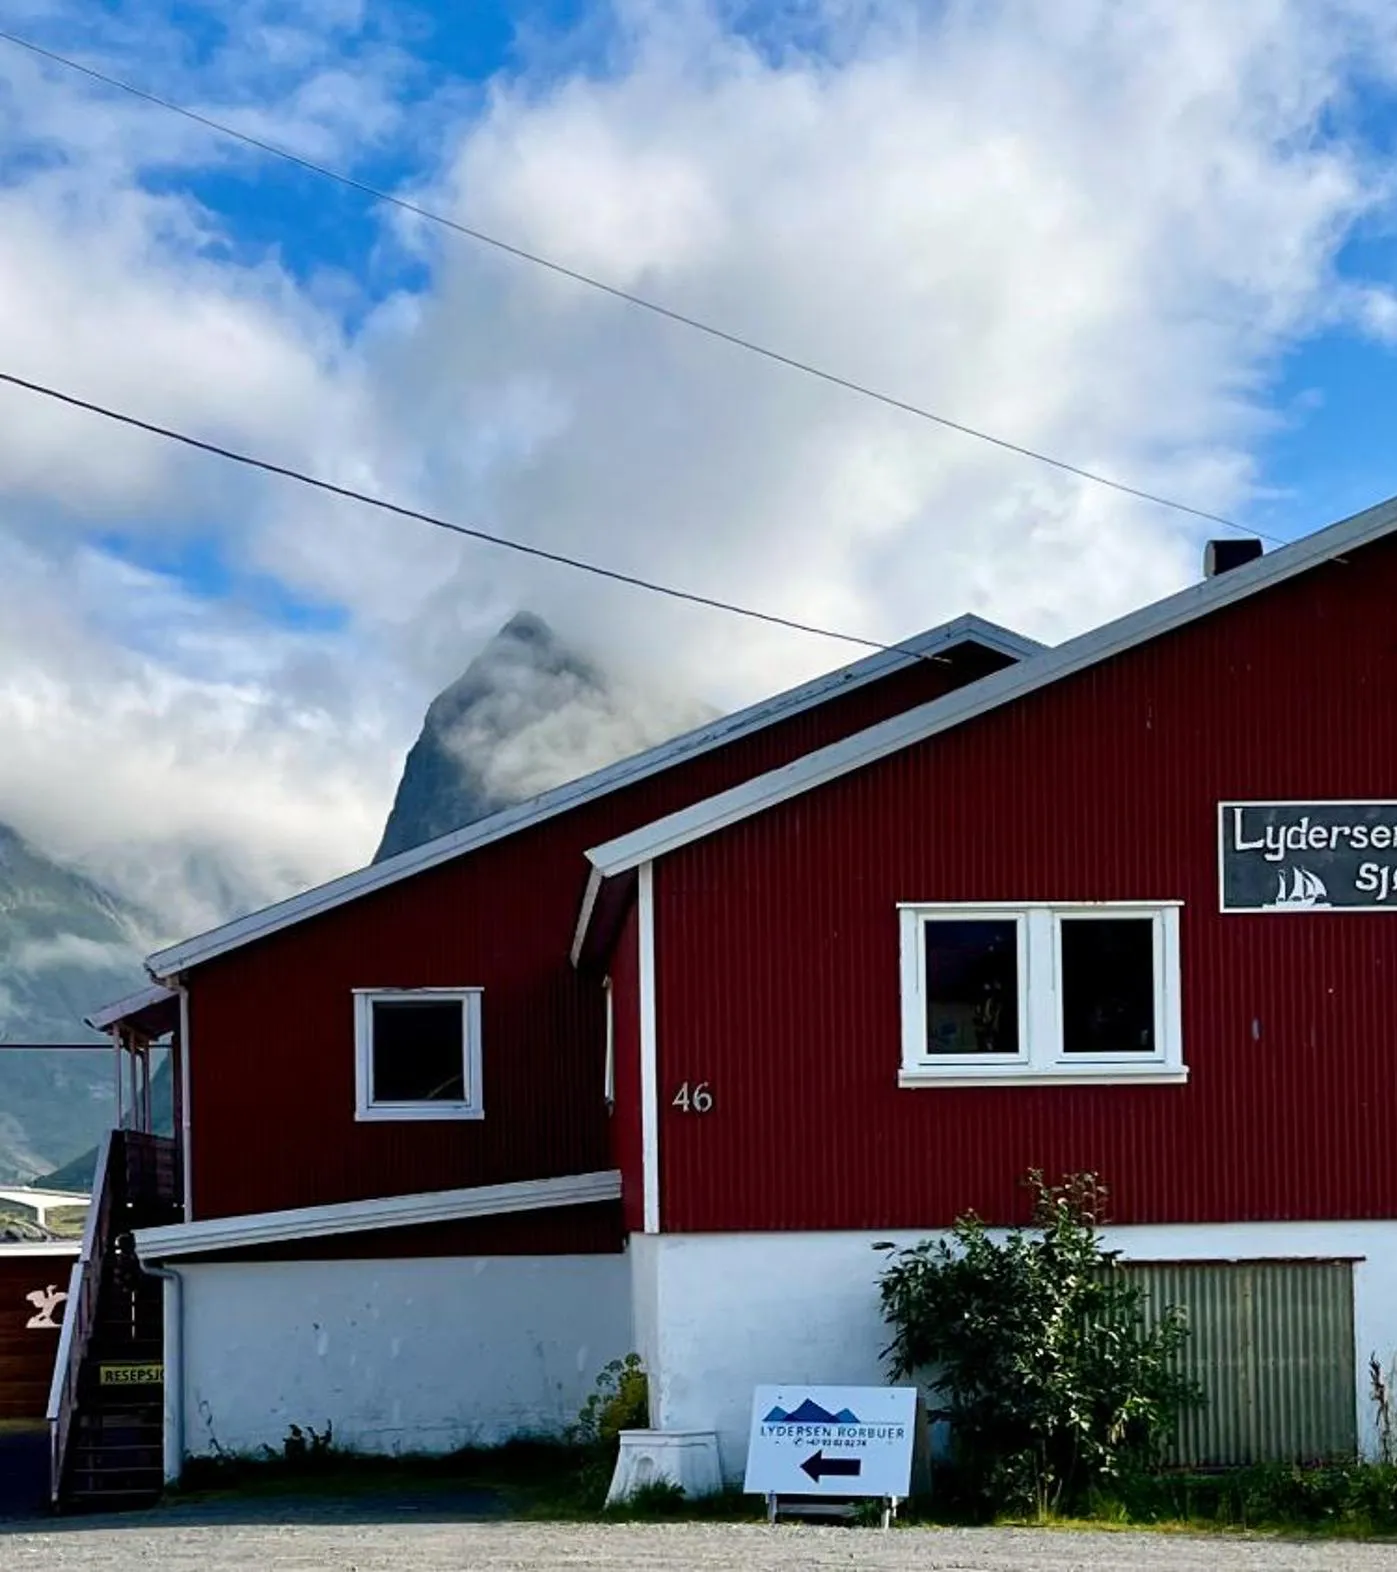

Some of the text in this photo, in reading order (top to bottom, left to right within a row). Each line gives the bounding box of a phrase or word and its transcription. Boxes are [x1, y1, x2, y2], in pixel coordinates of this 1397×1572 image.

[672, 1081, 712, 1112] 46
[760, 1425, 904, 1439] LYDERSEN RORBUER
